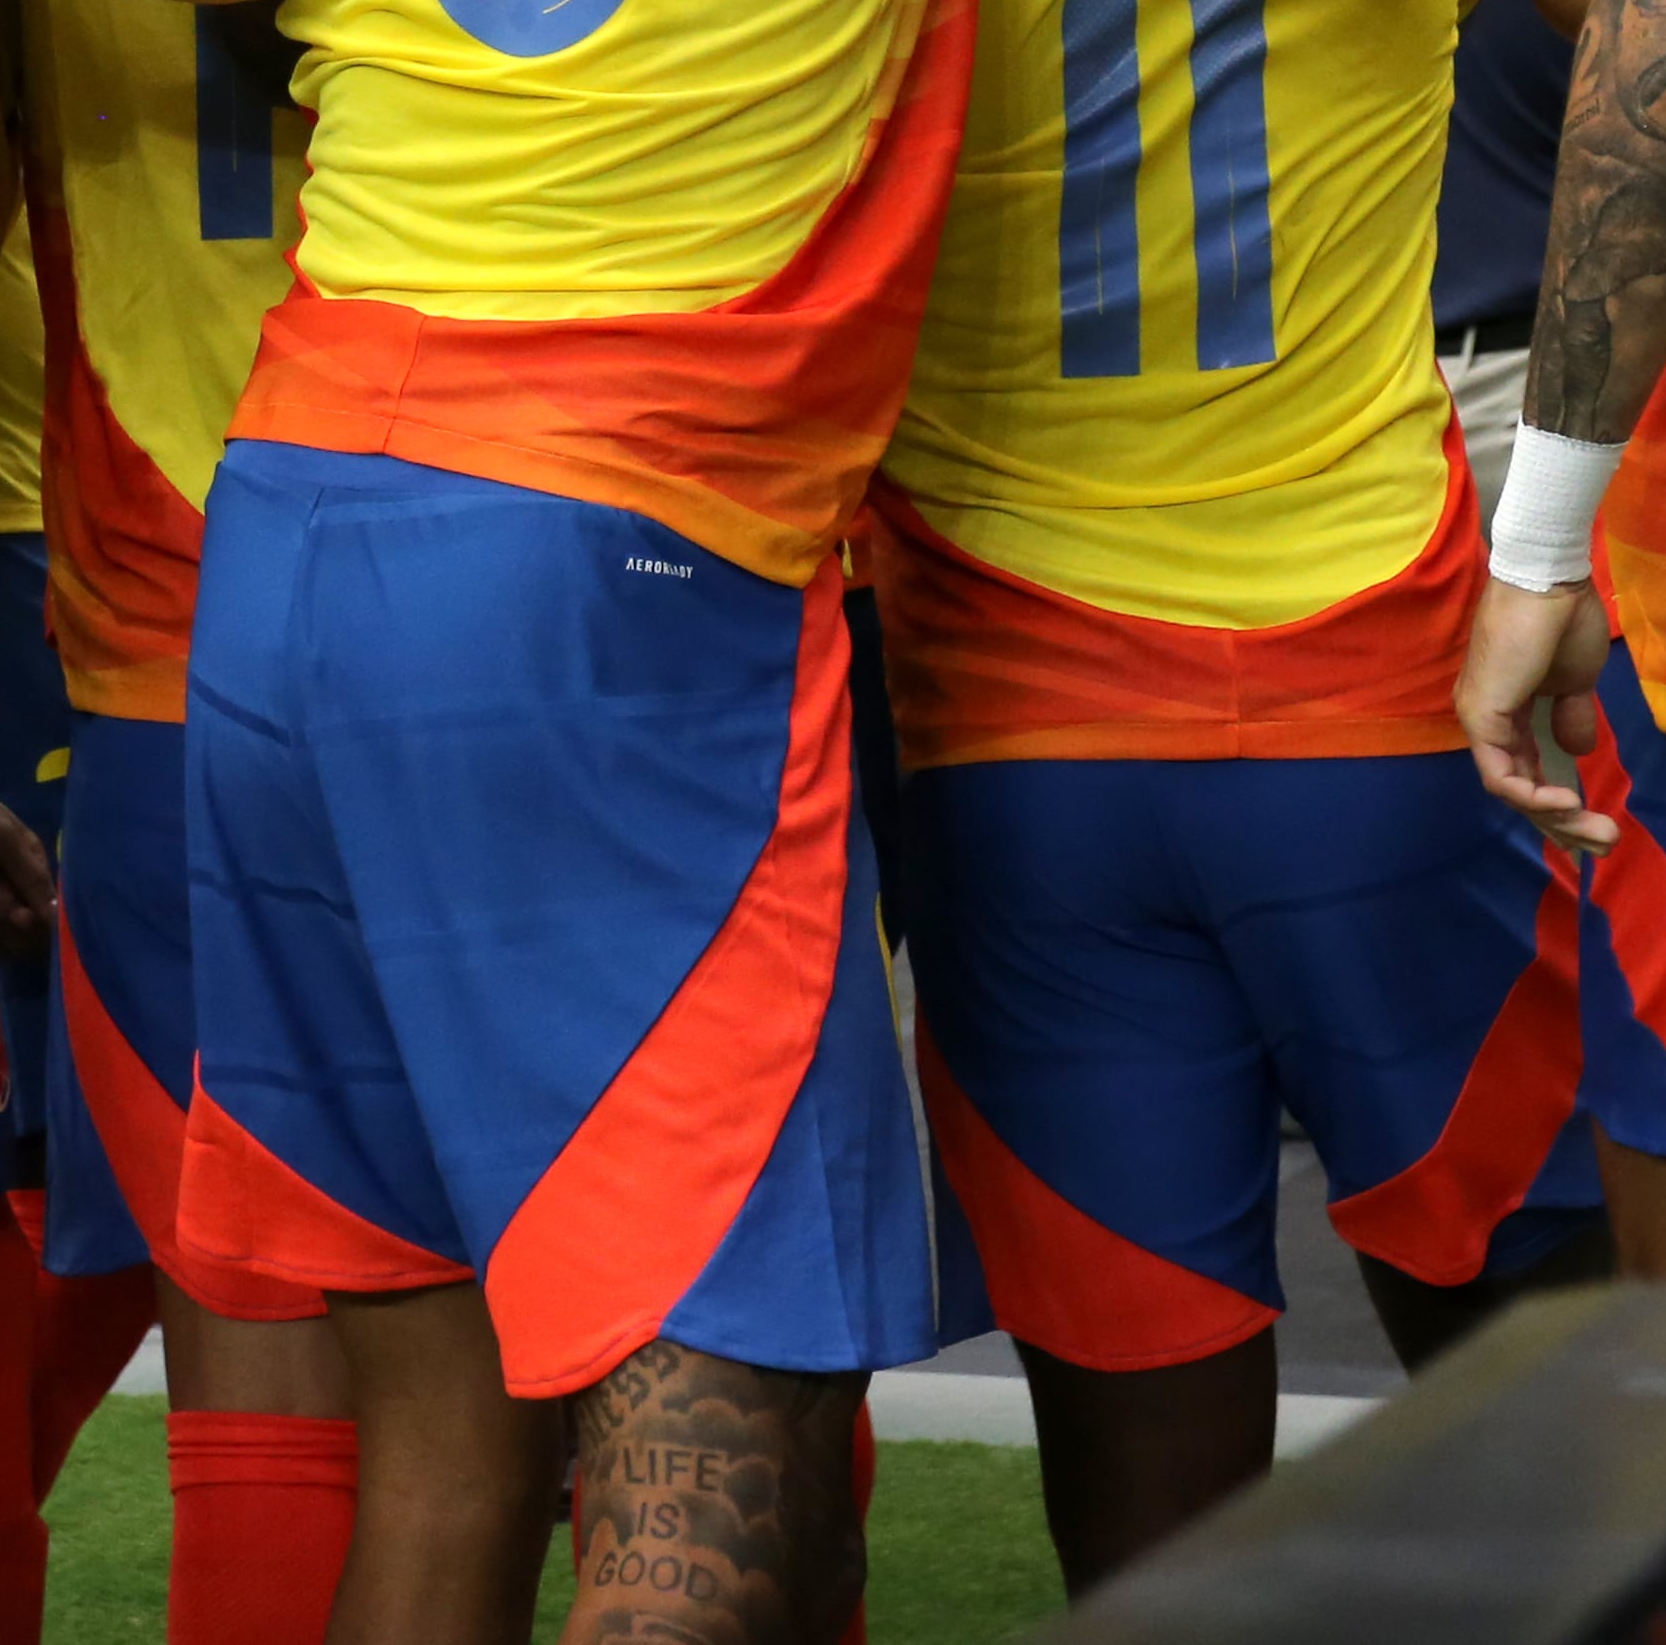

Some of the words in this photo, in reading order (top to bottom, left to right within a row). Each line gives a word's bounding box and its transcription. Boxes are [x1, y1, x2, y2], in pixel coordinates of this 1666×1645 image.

[622, 1447, 719, 1493] LIFE
[637, 1502, 681, 1540] IS
[594, 1551, 719, 1602] GOOD
